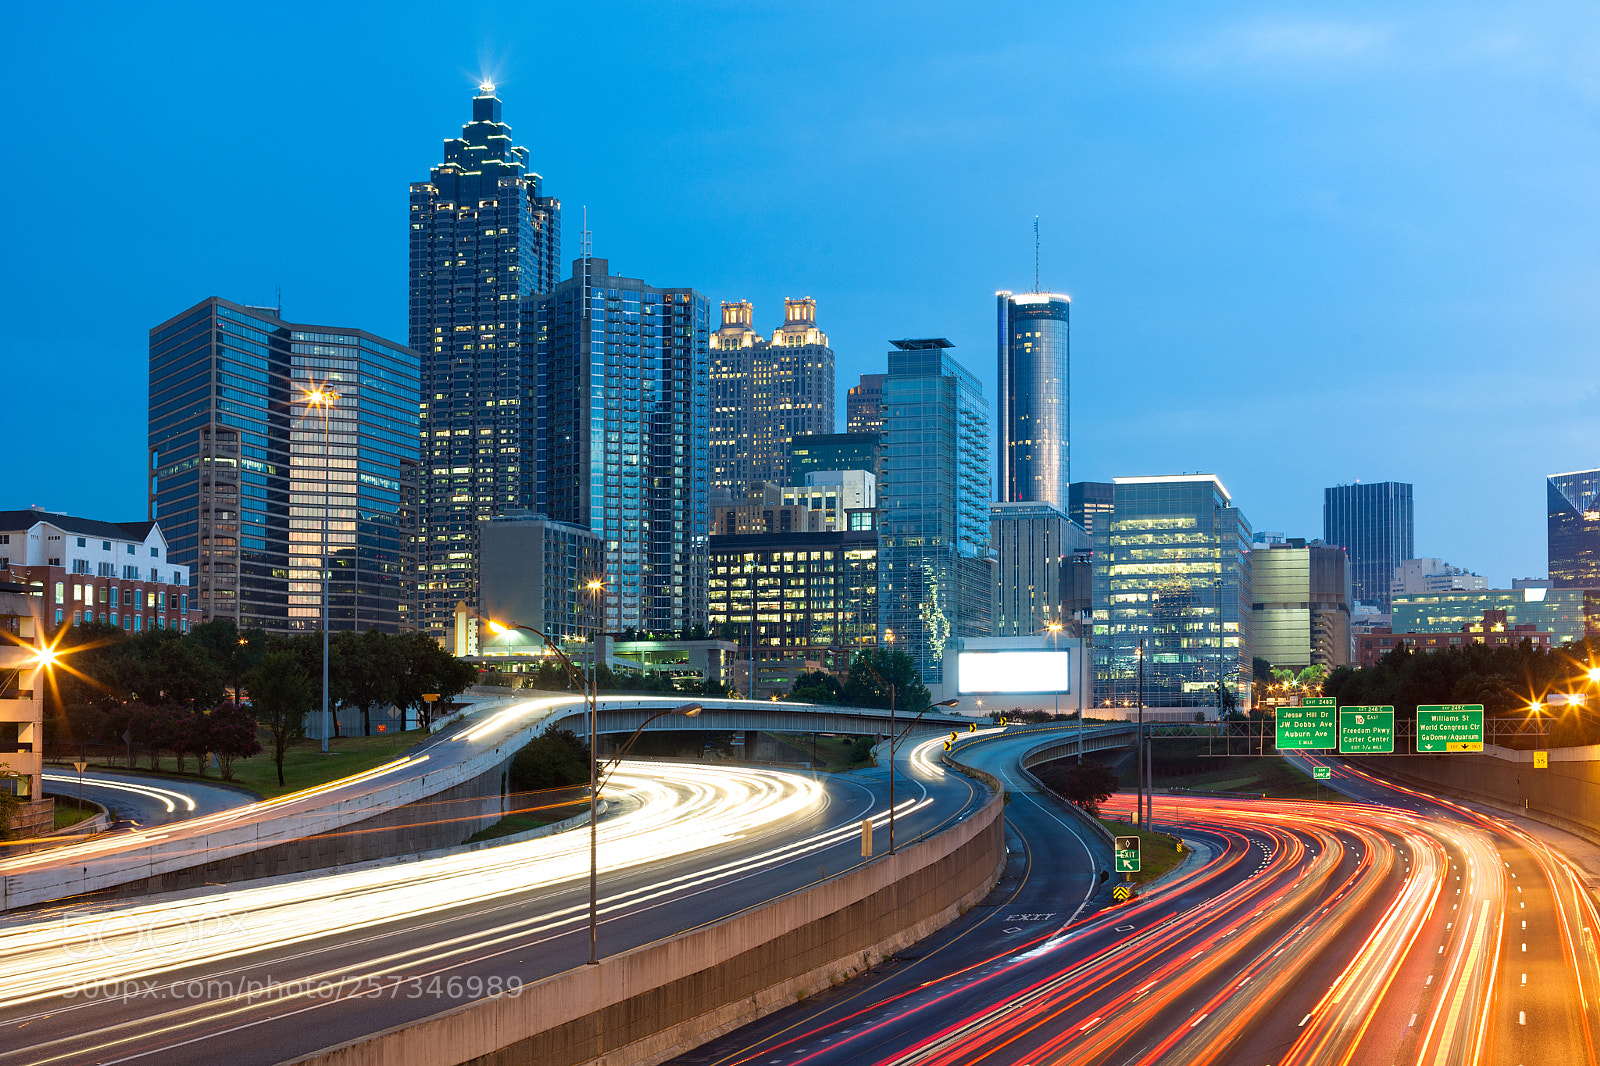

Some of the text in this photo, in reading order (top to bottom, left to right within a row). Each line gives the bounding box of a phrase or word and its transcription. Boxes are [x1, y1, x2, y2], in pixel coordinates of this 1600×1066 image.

[1372, 727, 1391, 735] Pkwy
[1439, 723, 1468, 732] Congress
[1120, 851, 1136, 859] EXIT
